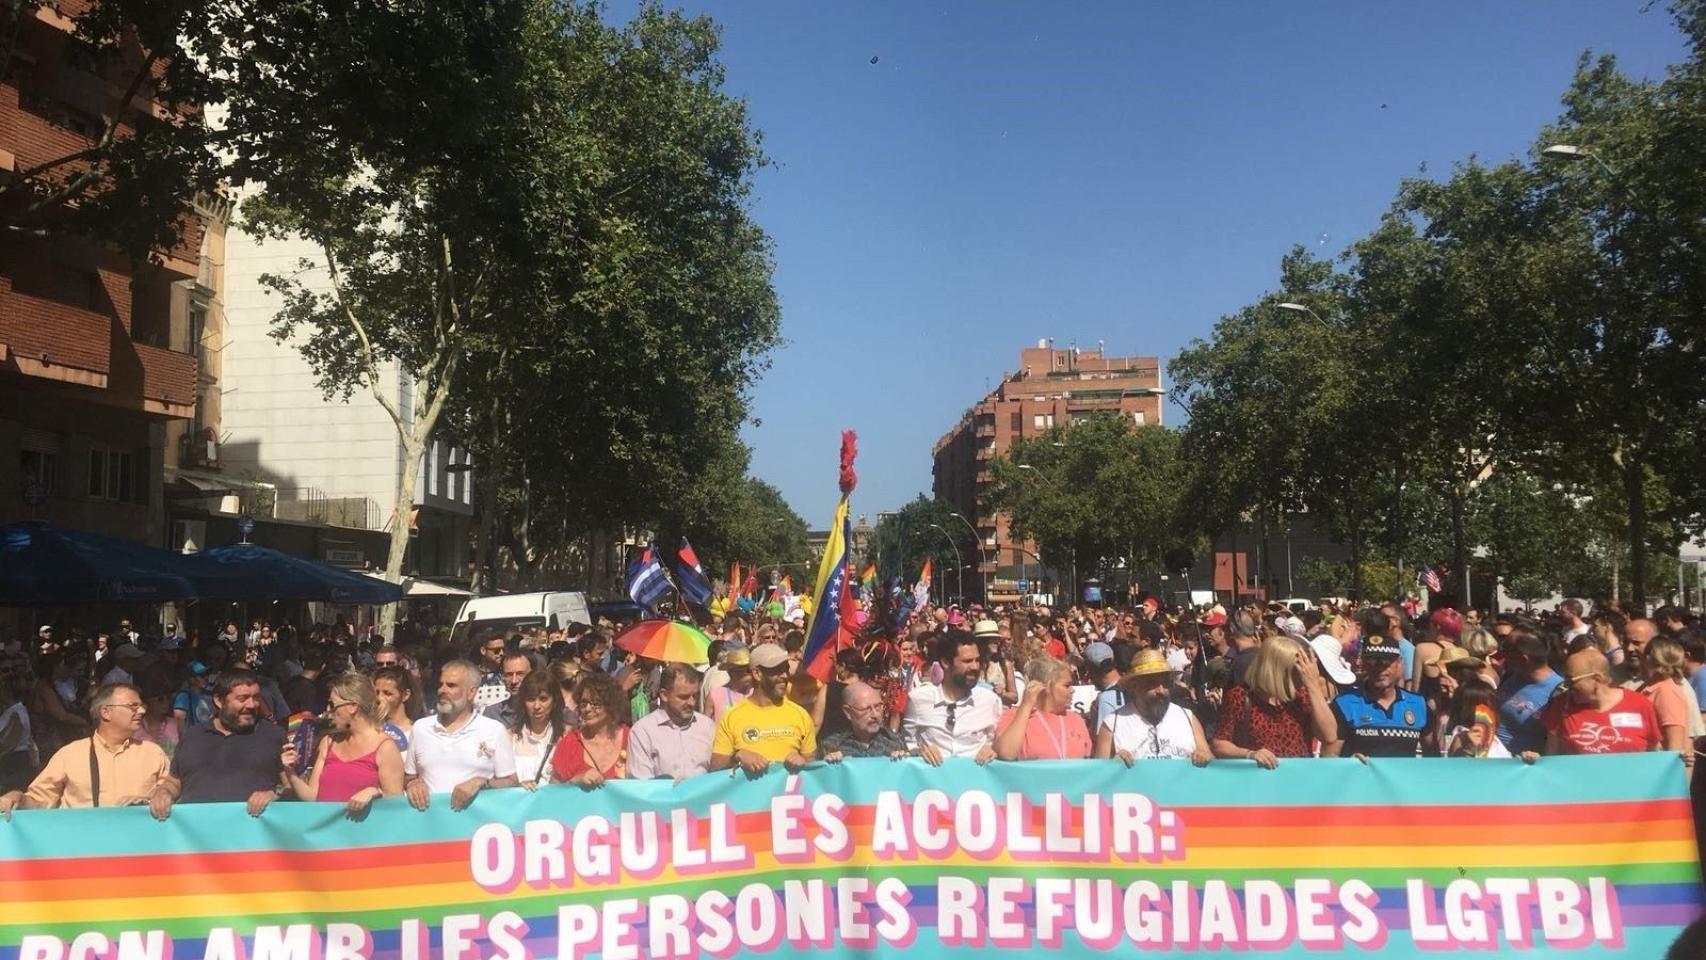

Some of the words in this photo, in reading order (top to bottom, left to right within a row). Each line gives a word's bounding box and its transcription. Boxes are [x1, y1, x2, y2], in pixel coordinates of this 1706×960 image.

[470, 803, 746, 887] ORGULL
[771, 774, 849, 855] ÉS
[873, 789, 1177, 854] ACOLLIR:
[557, 877, 911, 960] PERSONES
[937, 875, 1380, 943] REFUGIADES
[1406, 876, 1615, 942] LGTBI
